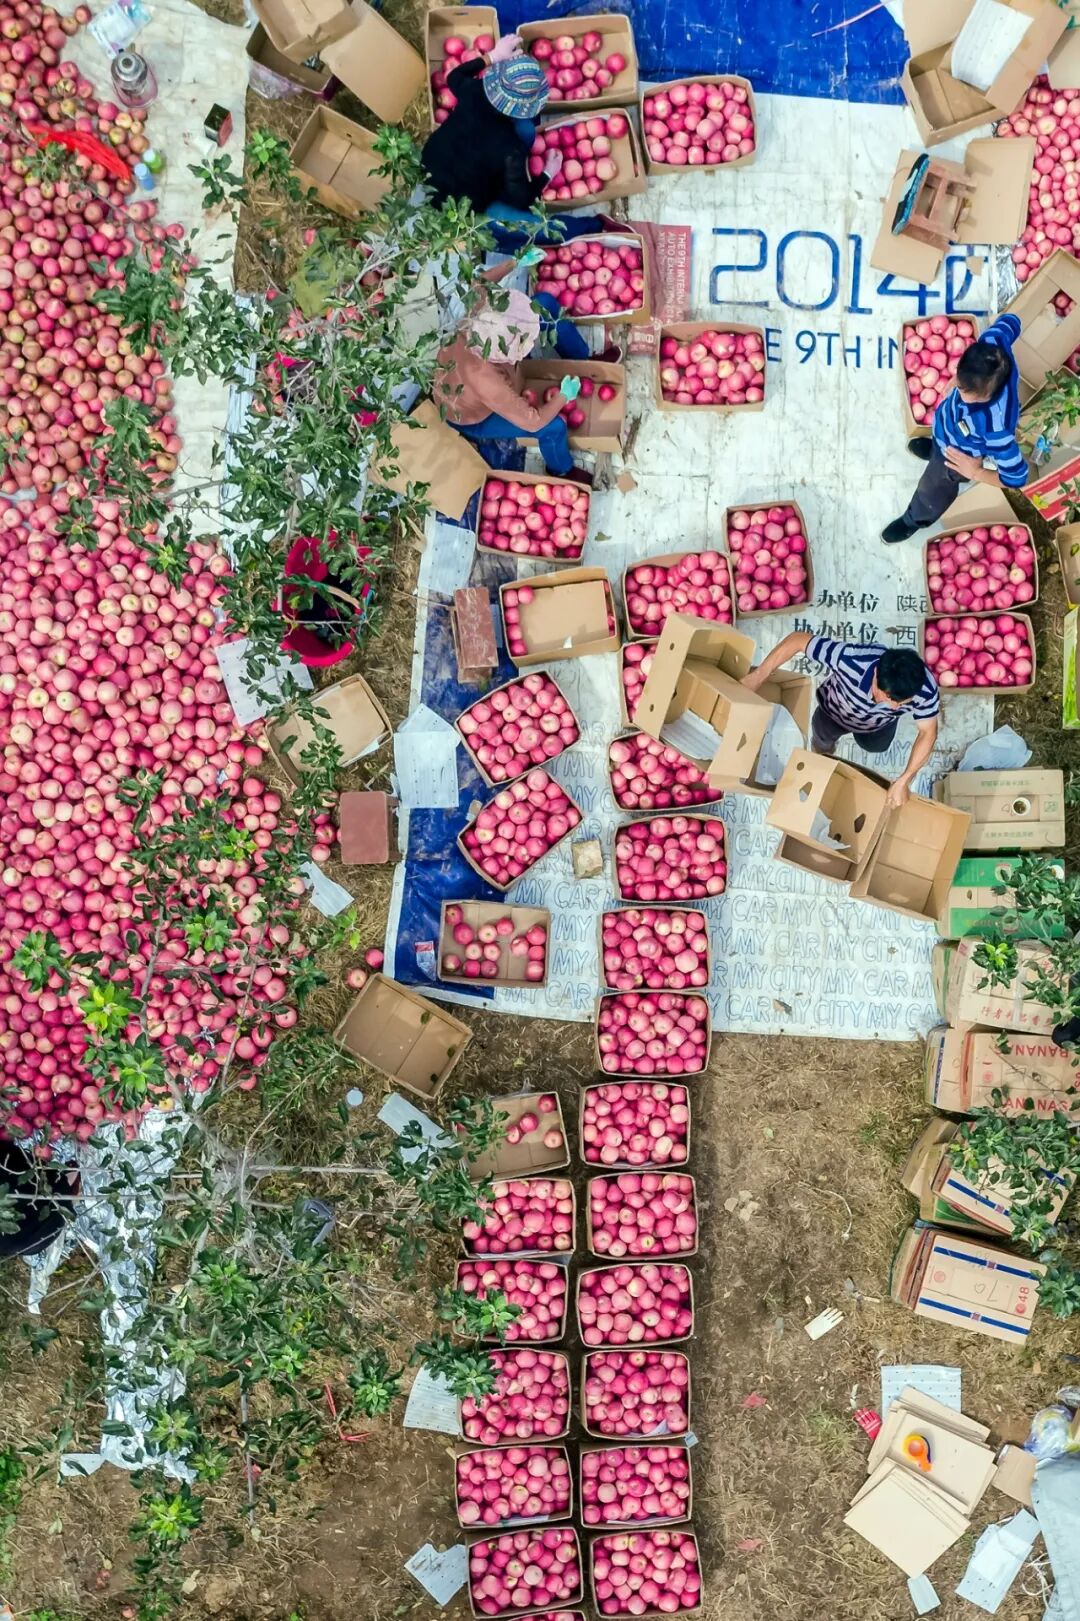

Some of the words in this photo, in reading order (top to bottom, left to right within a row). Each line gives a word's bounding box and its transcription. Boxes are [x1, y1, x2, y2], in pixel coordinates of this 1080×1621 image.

[796, 330, 861, 368] 9TH
[809, 589, 880, 613] 办单位
[895, 625, 917, 646] 西
[563, 752, 599, 779] MY
[515, 878, 551, 905] MY
[554, 881, 599, 911] CAR
[731, 894, 778, 924] CAR
[780, 898, 816, 927] MY
[819, 901, 867, 929] CITY
[555, 914, 593, 943] MY
[735, 928, 770, 956] MY
[775, 930, 821, 959] CAR
[825, 934, 860, 960] MY
[863, 935, 913, 963] CITY
[552, 948, 590, 976] MY
[732, 961, 768, 989] MY
[770, 964, 820, 993] CITY
[823, 967, 858, 995] MY
[863, 969, 909, 997] CAR
[545, 980, 592, 1010] CAR
[725, 994, 771, 1023] CAR
[814, 999, 865, 1028] CITY
[867, 1002, 902, 1029] MY
